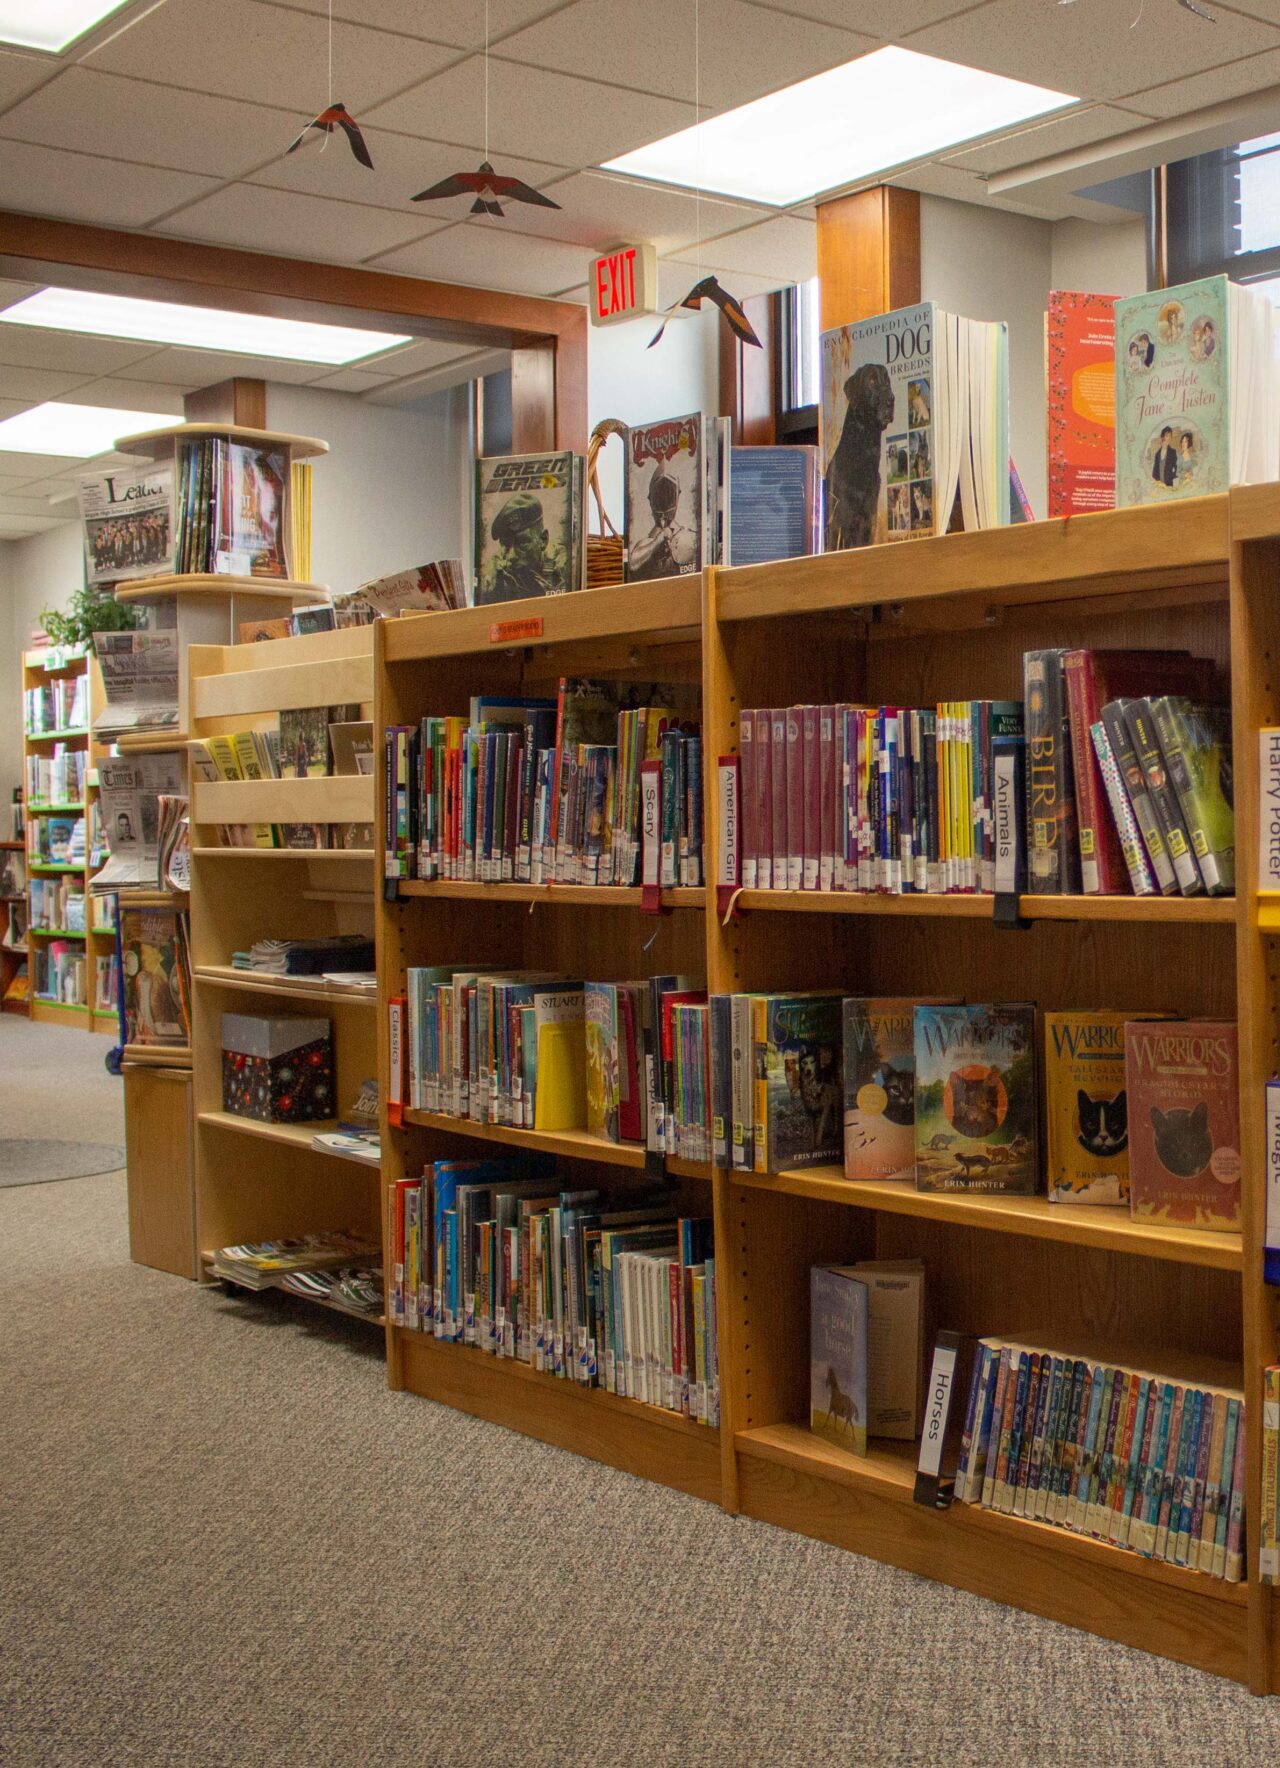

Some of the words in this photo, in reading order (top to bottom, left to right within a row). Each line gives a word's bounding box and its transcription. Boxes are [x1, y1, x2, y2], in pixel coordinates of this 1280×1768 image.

[595, 248, 636, 317] EXIT
[823, 316, 908, 349] ENCYCLOPEDIA
[915, 311, 930, 323] OF
[886, 324, 931, 364] DOG
[890, 357, 931, 376] BREEDS
[1148, 365, 1198, 401] Complete
[1136, 396, 1165, 425] Jane
[1179, 387, 1216, 411] Austen
[493, 457, 568, 478] GREEN
[679, 563, 697, 575] EDGE
[1001, 716, 1017, 725] VERY
[1113, 720, 1125, 746] HUNTER
[1136, 719, 1147, 745] HUNTER
[1157, 716, 1169, 743] HUNTER
[102, 770, 134, 787] Times
[1032, 736, 1058, 849] BIRD
[644, 789, 657, 838] Scary
[724, 770, 736, 844] American
[998, 775, 1010, 857] Animals
[726, 849, 736, 882] Girl
[541, 996, 579, 1010] STUART
[391, 1010, 399, 1065] Classics
[1129, 1035, 1231, 1077] WARRIORS
[944, 1179, 965, 1188] ERIN
[968, 1180, 1005, 1189] HUNTER
[825, 1327, 851, 1353] horse
[831, 1314, 855, 1337] good
[928, 1373, 949, 1441] Horses
